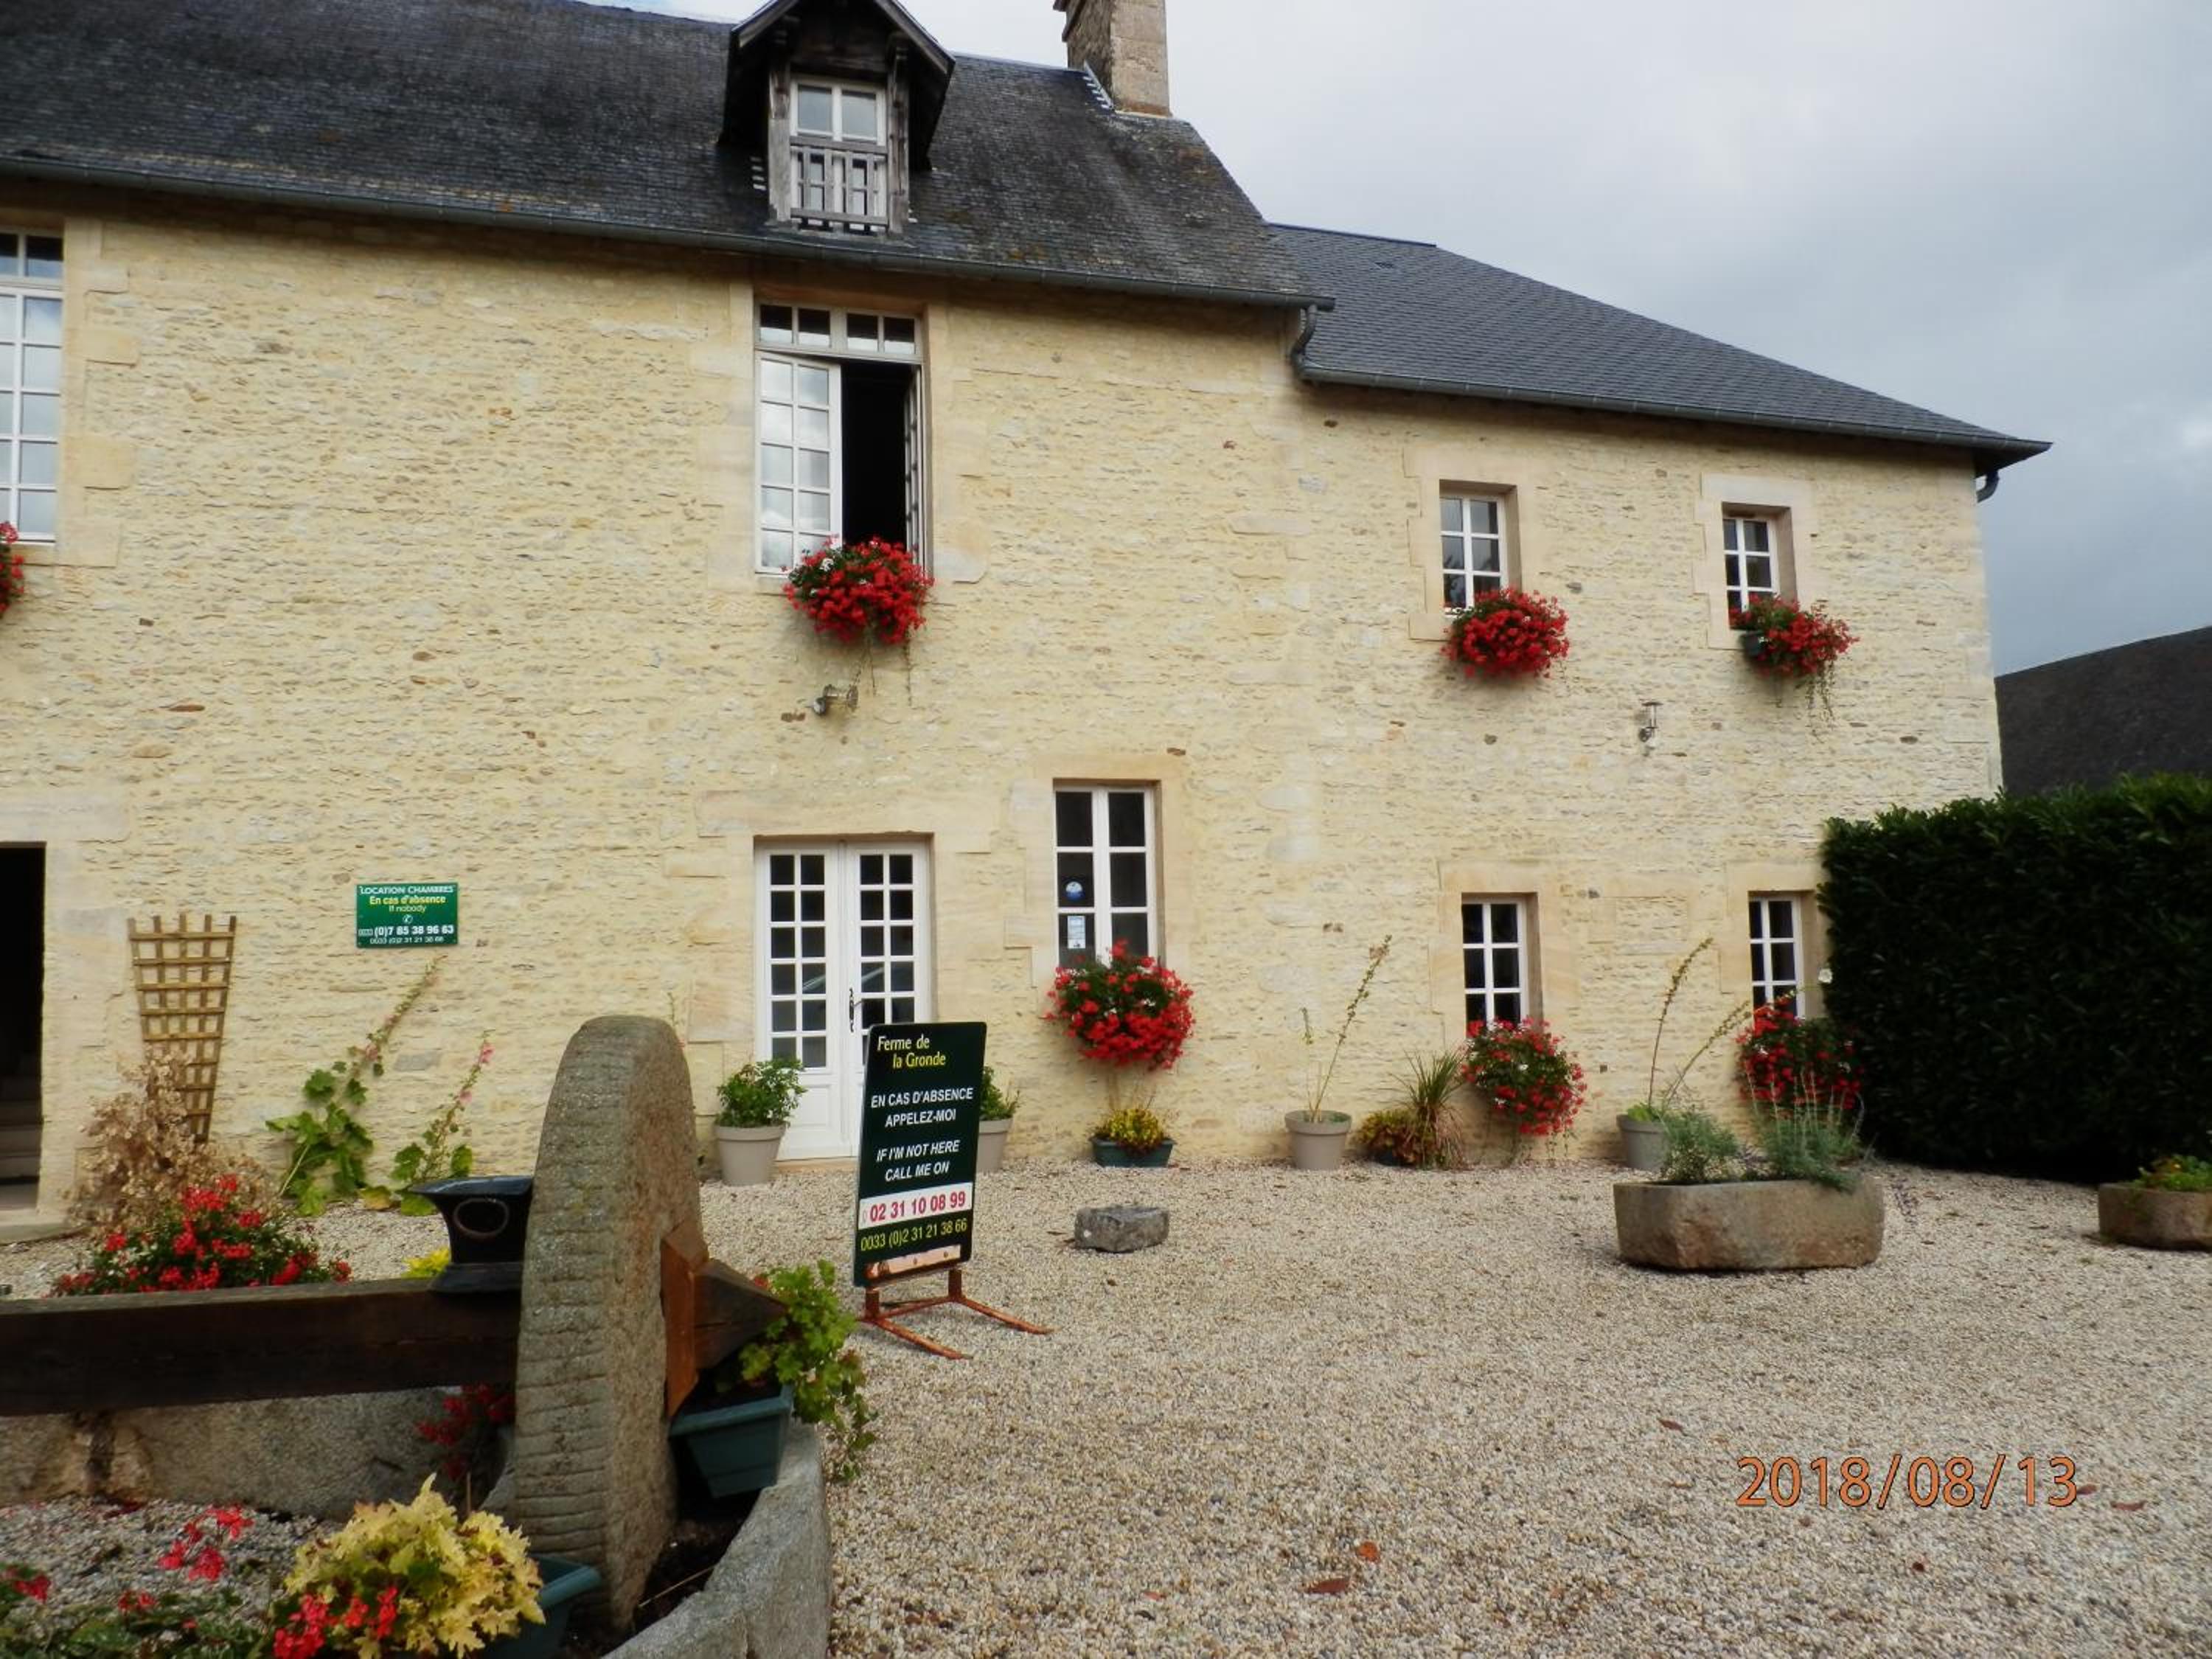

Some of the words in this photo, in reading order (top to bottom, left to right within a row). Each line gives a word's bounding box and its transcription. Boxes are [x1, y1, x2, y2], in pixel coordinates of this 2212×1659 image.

[361, 886, 405, 894] LOCATION
[369, 896, 381, 905] En
[400, 895, 446, 905] d'absence
[396, 905, 427, 914] nobody
[374, 926, 394, 938] (0)7
[396, 926, 409, 935] 85
[411, 925, 425, 934] 38
[426, 925, 439, 933] 96
[442, 925, 454, 933] 63
[877, 1035, 912, 1051] Ferme
[917, 1033, 930, 1049] de
[893, 1053, 902, 1069] la
[905, 1051, 946, 1067] Gronde
[871, 1094, 886, 1108] EN
[888, 1092, 909, 1106] CAS
[912, 1088, 974, 1104] D'ABSENCE
[885, 1108, 956, 1127] APPELEZ-MOI
[876, 1148, 887, 1163] IF
[888, 1145, 904, 1161] I'M
[905, 1143, 929, 1158] NOT
[931, 1139, 961, 1155] HERE
[885, 1166, 912, 1182] CALL
[915, 1163, 931, 1177] ME
[933, 1161, 950, 1175] ON
[870, 1203, 886, 1222] 02
[890, 1200, 905, 1219] 31
[911, 1197, 927, 1215] 10
[930, 1194, 946, 1211] 08
[950, 1190, 966, 1208] 99
[860, 1233, 886, 1251] 0033
[888, 1229, 908, 1248] (0)2
[911, 1226, 922, 1241] 31
[926, 1224, 937, 1238] 21
[940, 1220, 953, 1235] 38
[955, 1217, 967, 1233] 66
